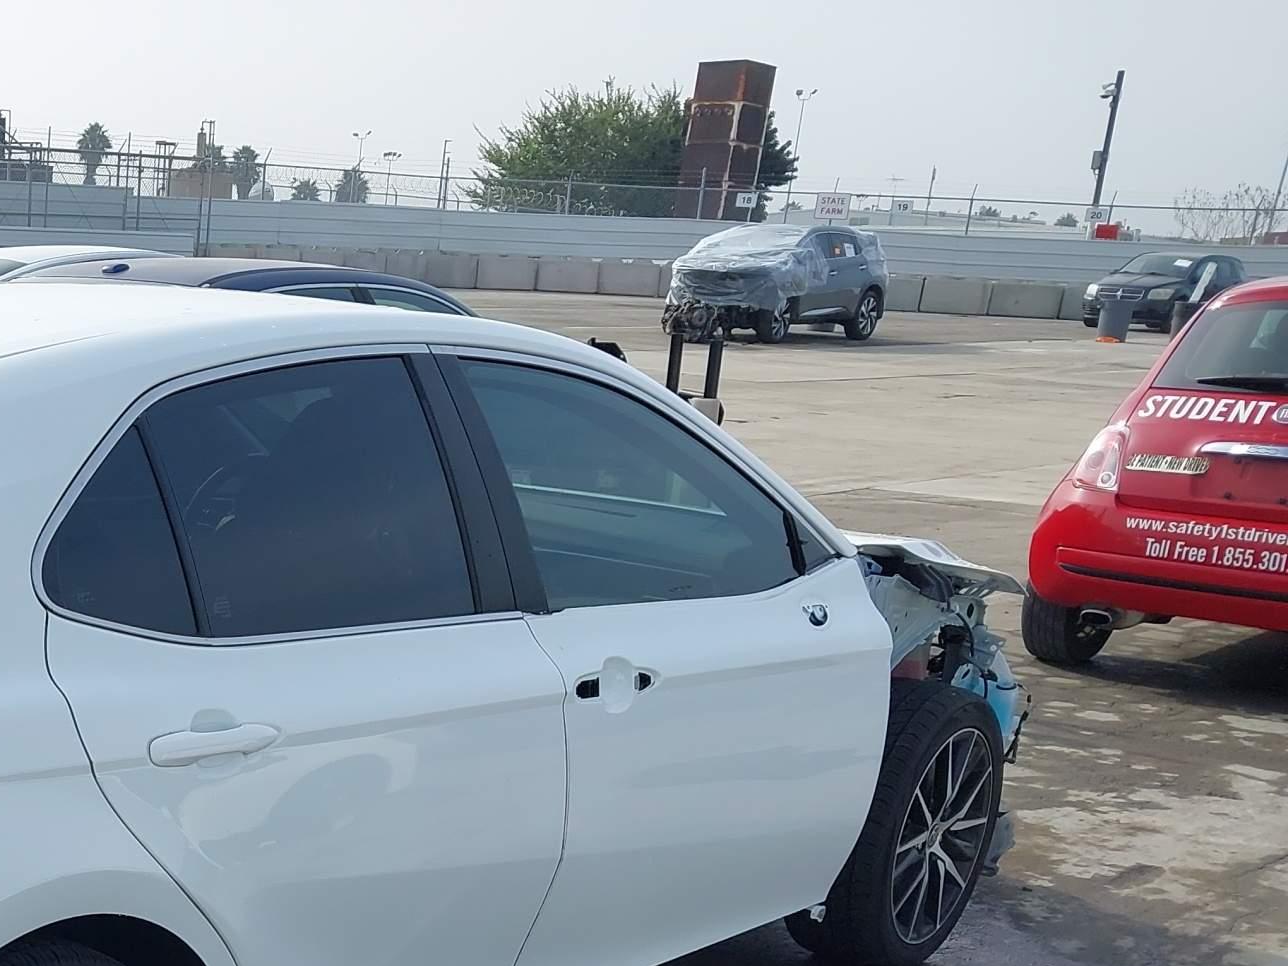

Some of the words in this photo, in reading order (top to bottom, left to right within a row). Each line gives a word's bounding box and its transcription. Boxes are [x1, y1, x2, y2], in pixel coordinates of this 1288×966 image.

[741, 196, 752, 204] 18
[821, 196, 846, 205] STATE
[819, 207, 844, 216] FARM
[897, 203, 909, 211] 19
[1090, 211, 1103, 219] 20
[1138, 395, 1277, 424] STUDENT
[1136, 455, 1163, 469] PATIENT
[1145, 537, 1170, 559] Toll
[1173, 541, 1207, 563] Free
